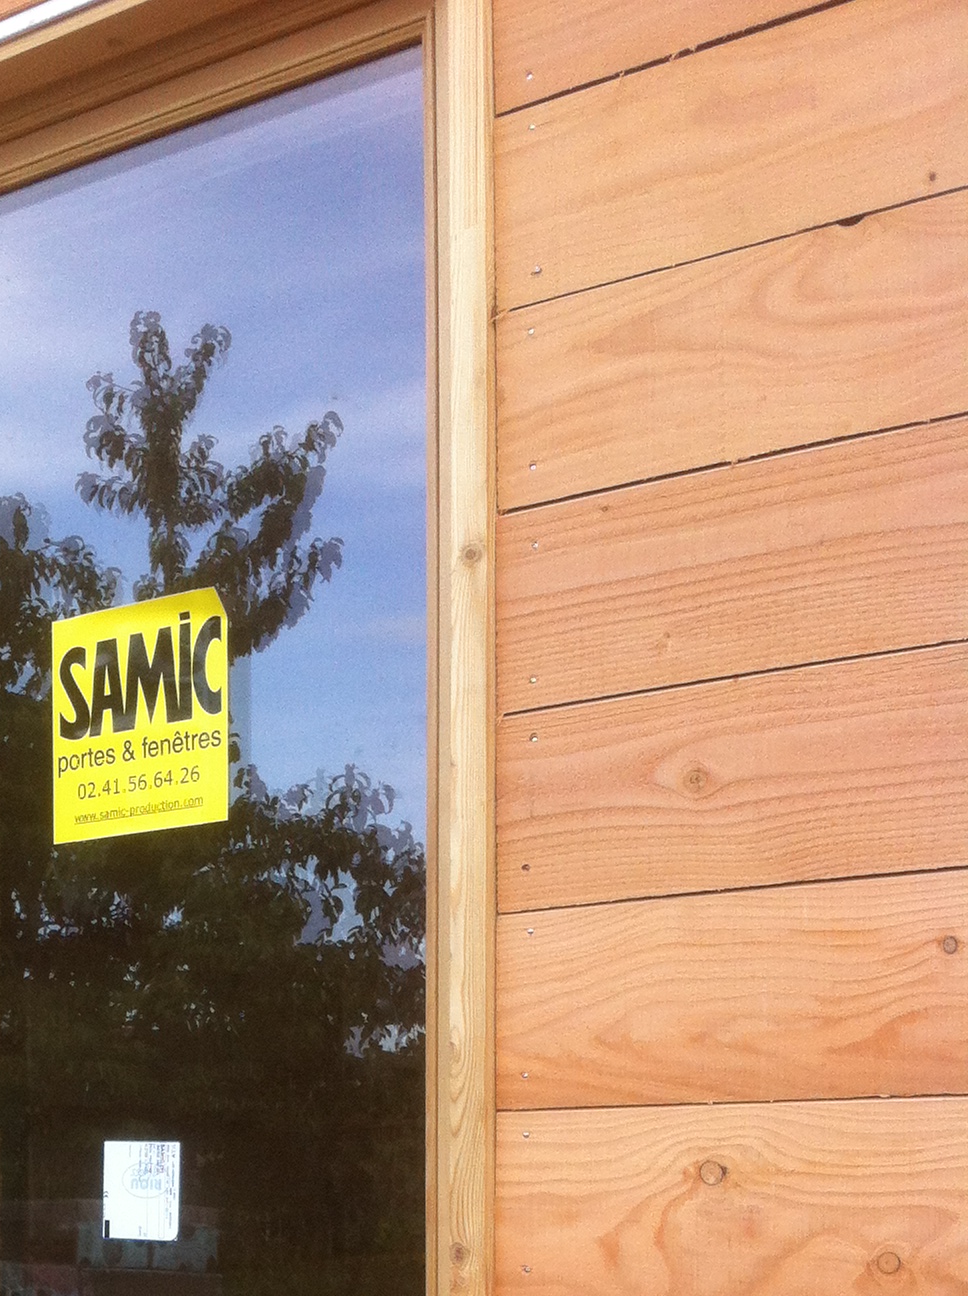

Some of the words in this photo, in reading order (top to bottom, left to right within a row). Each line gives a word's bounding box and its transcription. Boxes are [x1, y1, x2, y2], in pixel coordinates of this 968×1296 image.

[58, 747, 116, 778] portes
[122, 740, 136, 762] &
[141, 730, 222, 759] fenêtres
[77, 765, 200, 800] 02.41.56.64.26
[74, 796, 204, 824] www.samic-production.com
